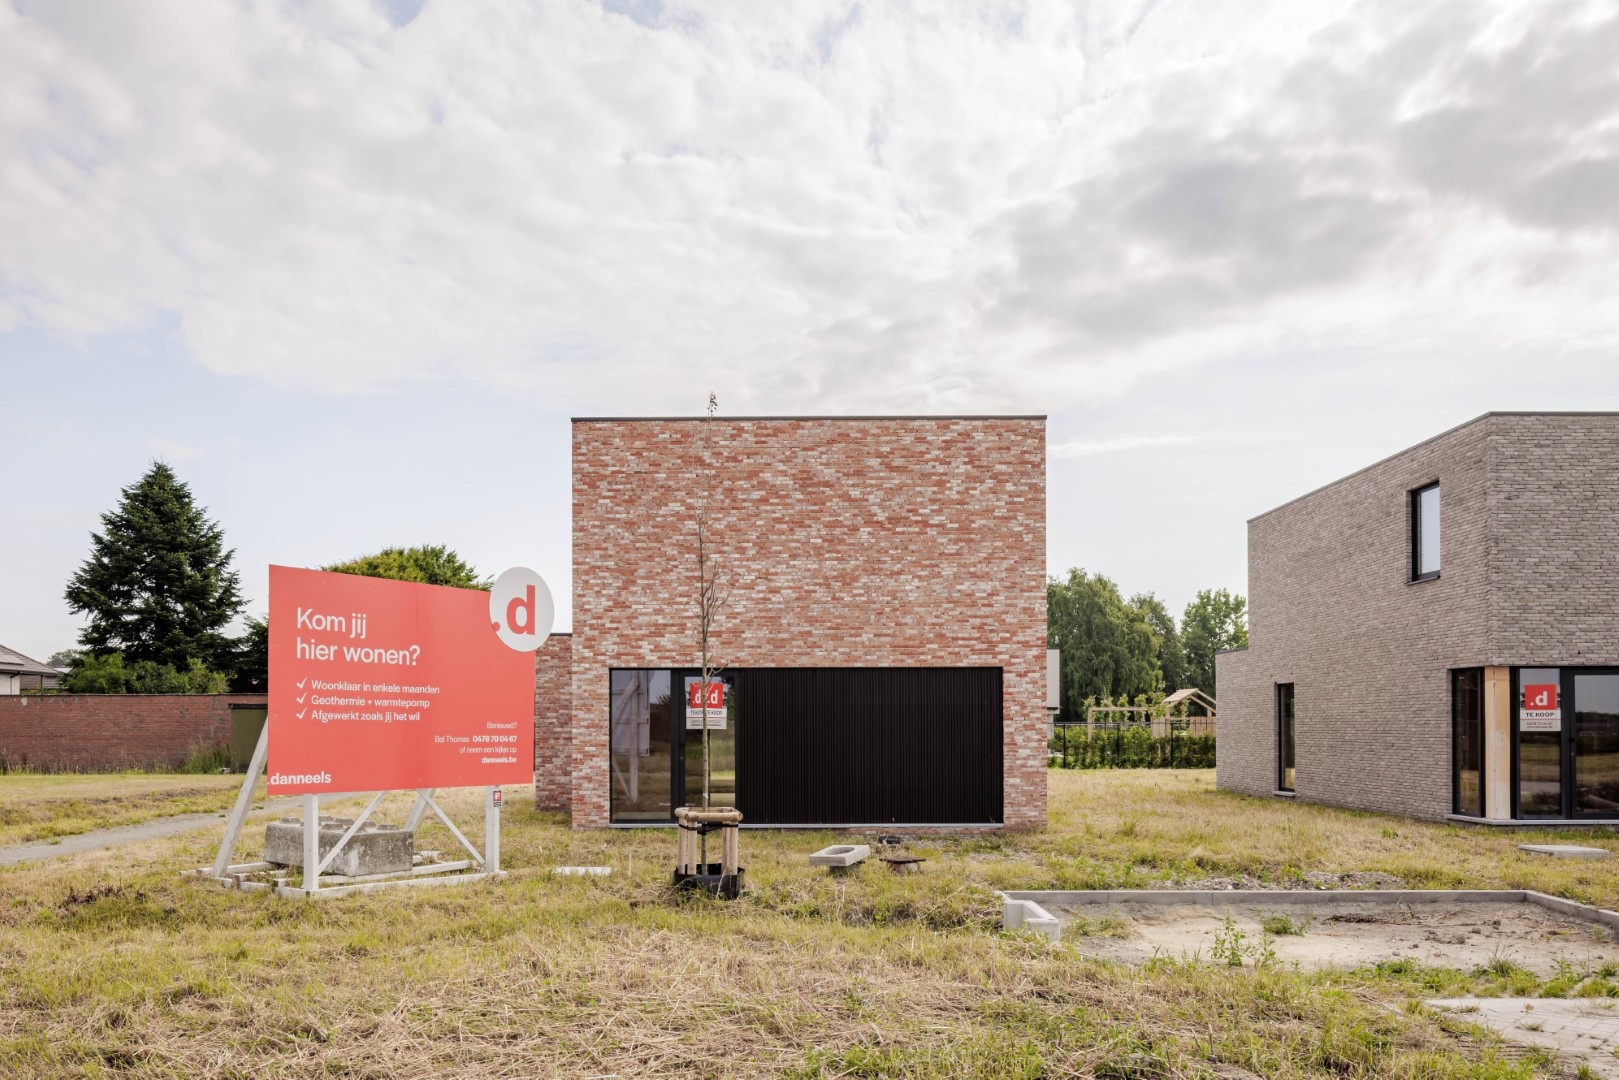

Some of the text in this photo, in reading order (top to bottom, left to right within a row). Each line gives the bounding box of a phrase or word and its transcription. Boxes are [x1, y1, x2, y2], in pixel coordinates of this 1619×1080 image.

[297, 607, 366, 639] Kom jij
[297, 637, 421, 666] hier wonen?
[311, 680, 440, 694] Woonklaar in enkele maanden
[311, 695, 365, 706] Geothermie
[374, 699, 430, 709] warmtepomp
[1530, 691, 1548, 706] .d
[311, 710, 359, 722] Afgewerkt
[361, 711, 383, 721] zoals
[394, 712, 407, 721] het
[409, 712, 421, 721] wil
[434, 735, 517, 743] Bel Thomas 0478 70 04 67
